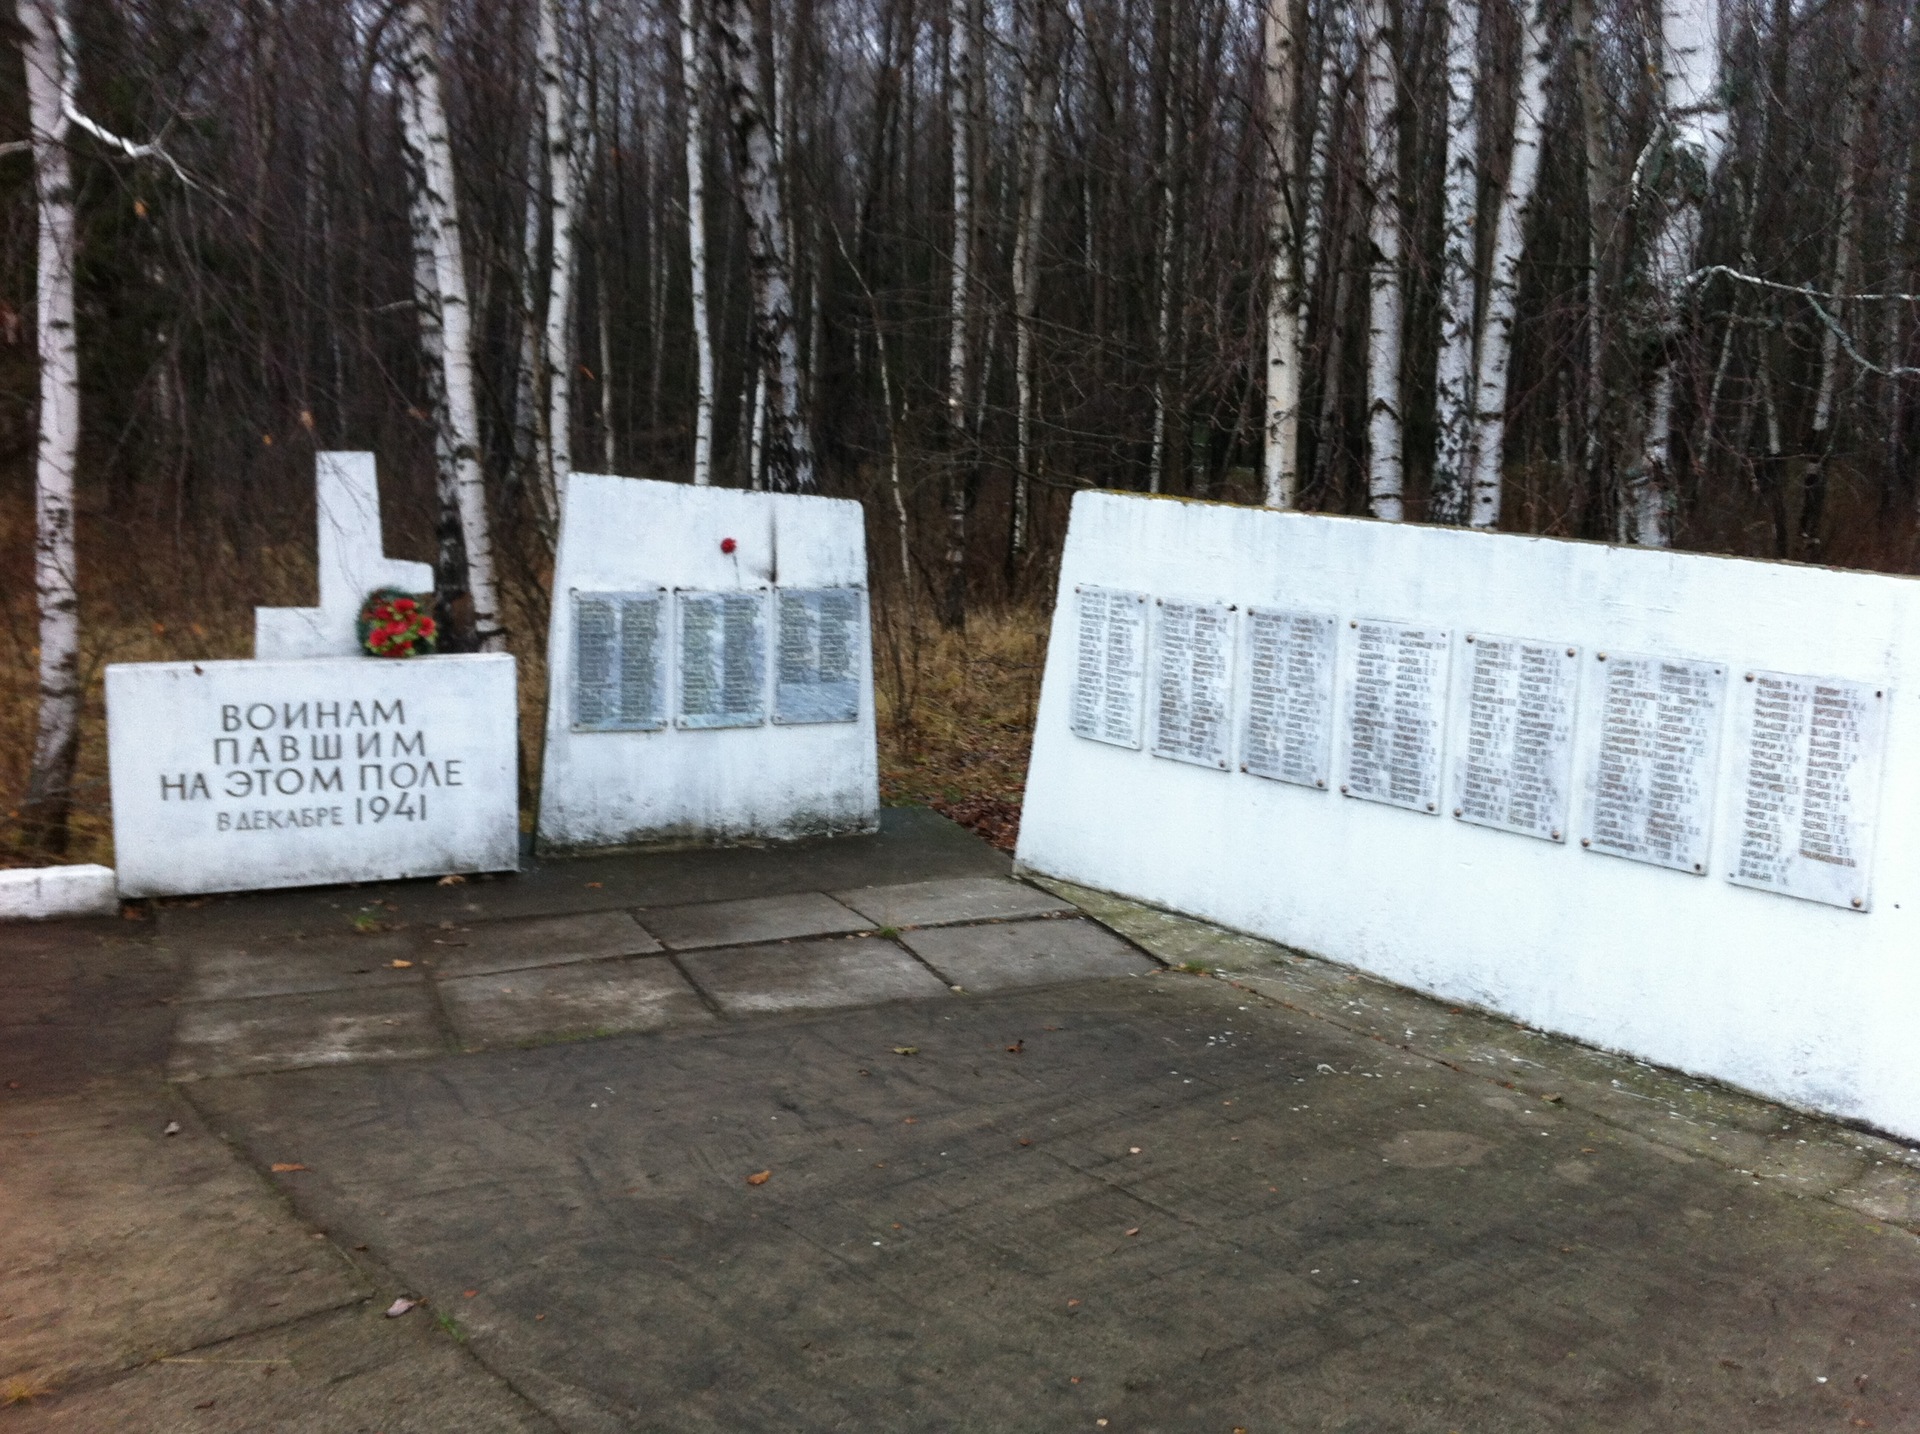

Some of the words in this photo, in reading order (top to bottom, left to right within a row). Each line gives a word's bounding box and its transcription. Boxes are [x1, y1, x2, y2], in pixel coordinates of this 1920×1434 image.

[221, 699, 405, 732] ВОИНАМ
[214, 731, 426, 765] ПАВШИМ
[160, 772, 211, 801] НА
[225, 766, 344, 798] ЭТОМ
[359, 760, 463, 791] ПОЛЕ
[216, 811, 231, 832] В
[235, 806, 344, 831] ДЕКАБРЕ
[355, 792, 427, 824] 1941
